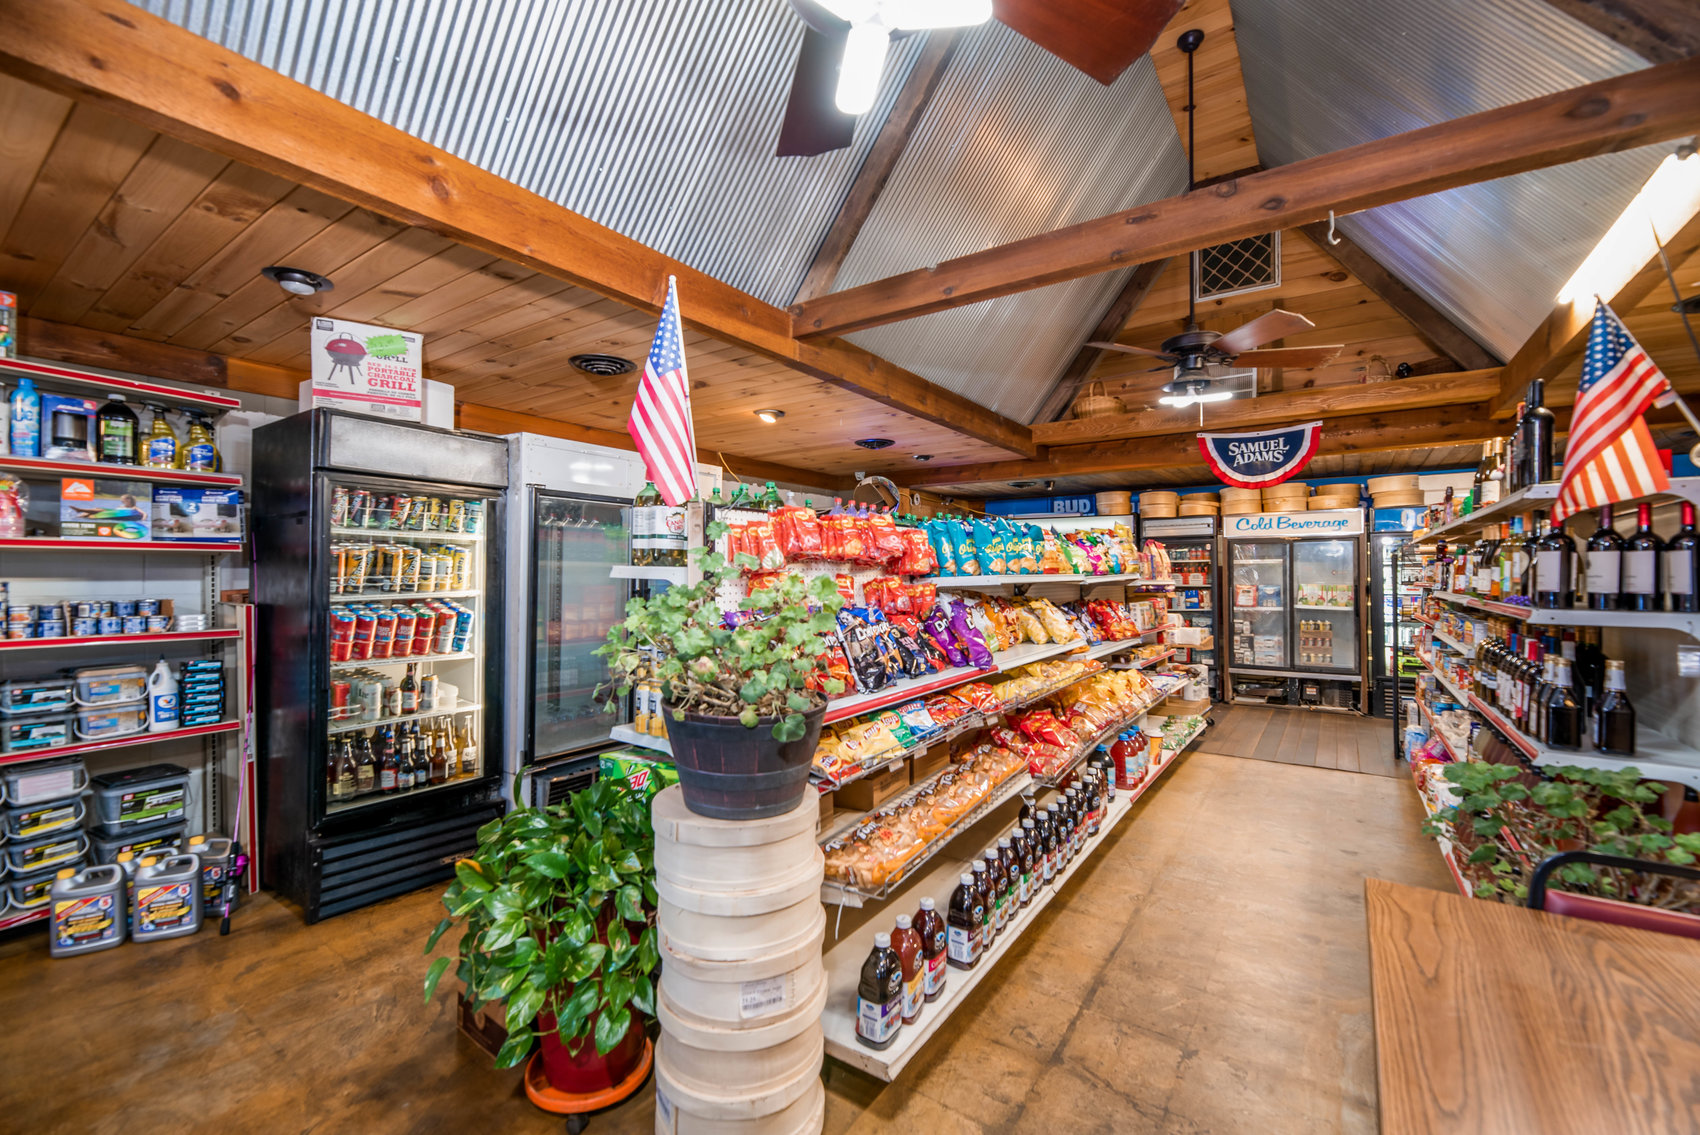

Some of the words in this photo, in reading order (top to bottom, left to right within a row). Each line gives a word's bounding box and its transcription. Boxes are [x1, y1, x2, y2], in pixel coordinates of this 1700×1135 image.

[367, 365, 417, 378] PORTABLE
[367, 371, 417, 384] CHARCOAL
[367, 377, 417, 392] GRILL
[1228, 437, 1290, 456] SAMUEL
[1233, 449, 1286, 467] ADAMS
[1053, 499, 1091, 513] BUD
[1236, 516, 1272, 531] Cold
[1276, 516, 1350, 532] Beverage
